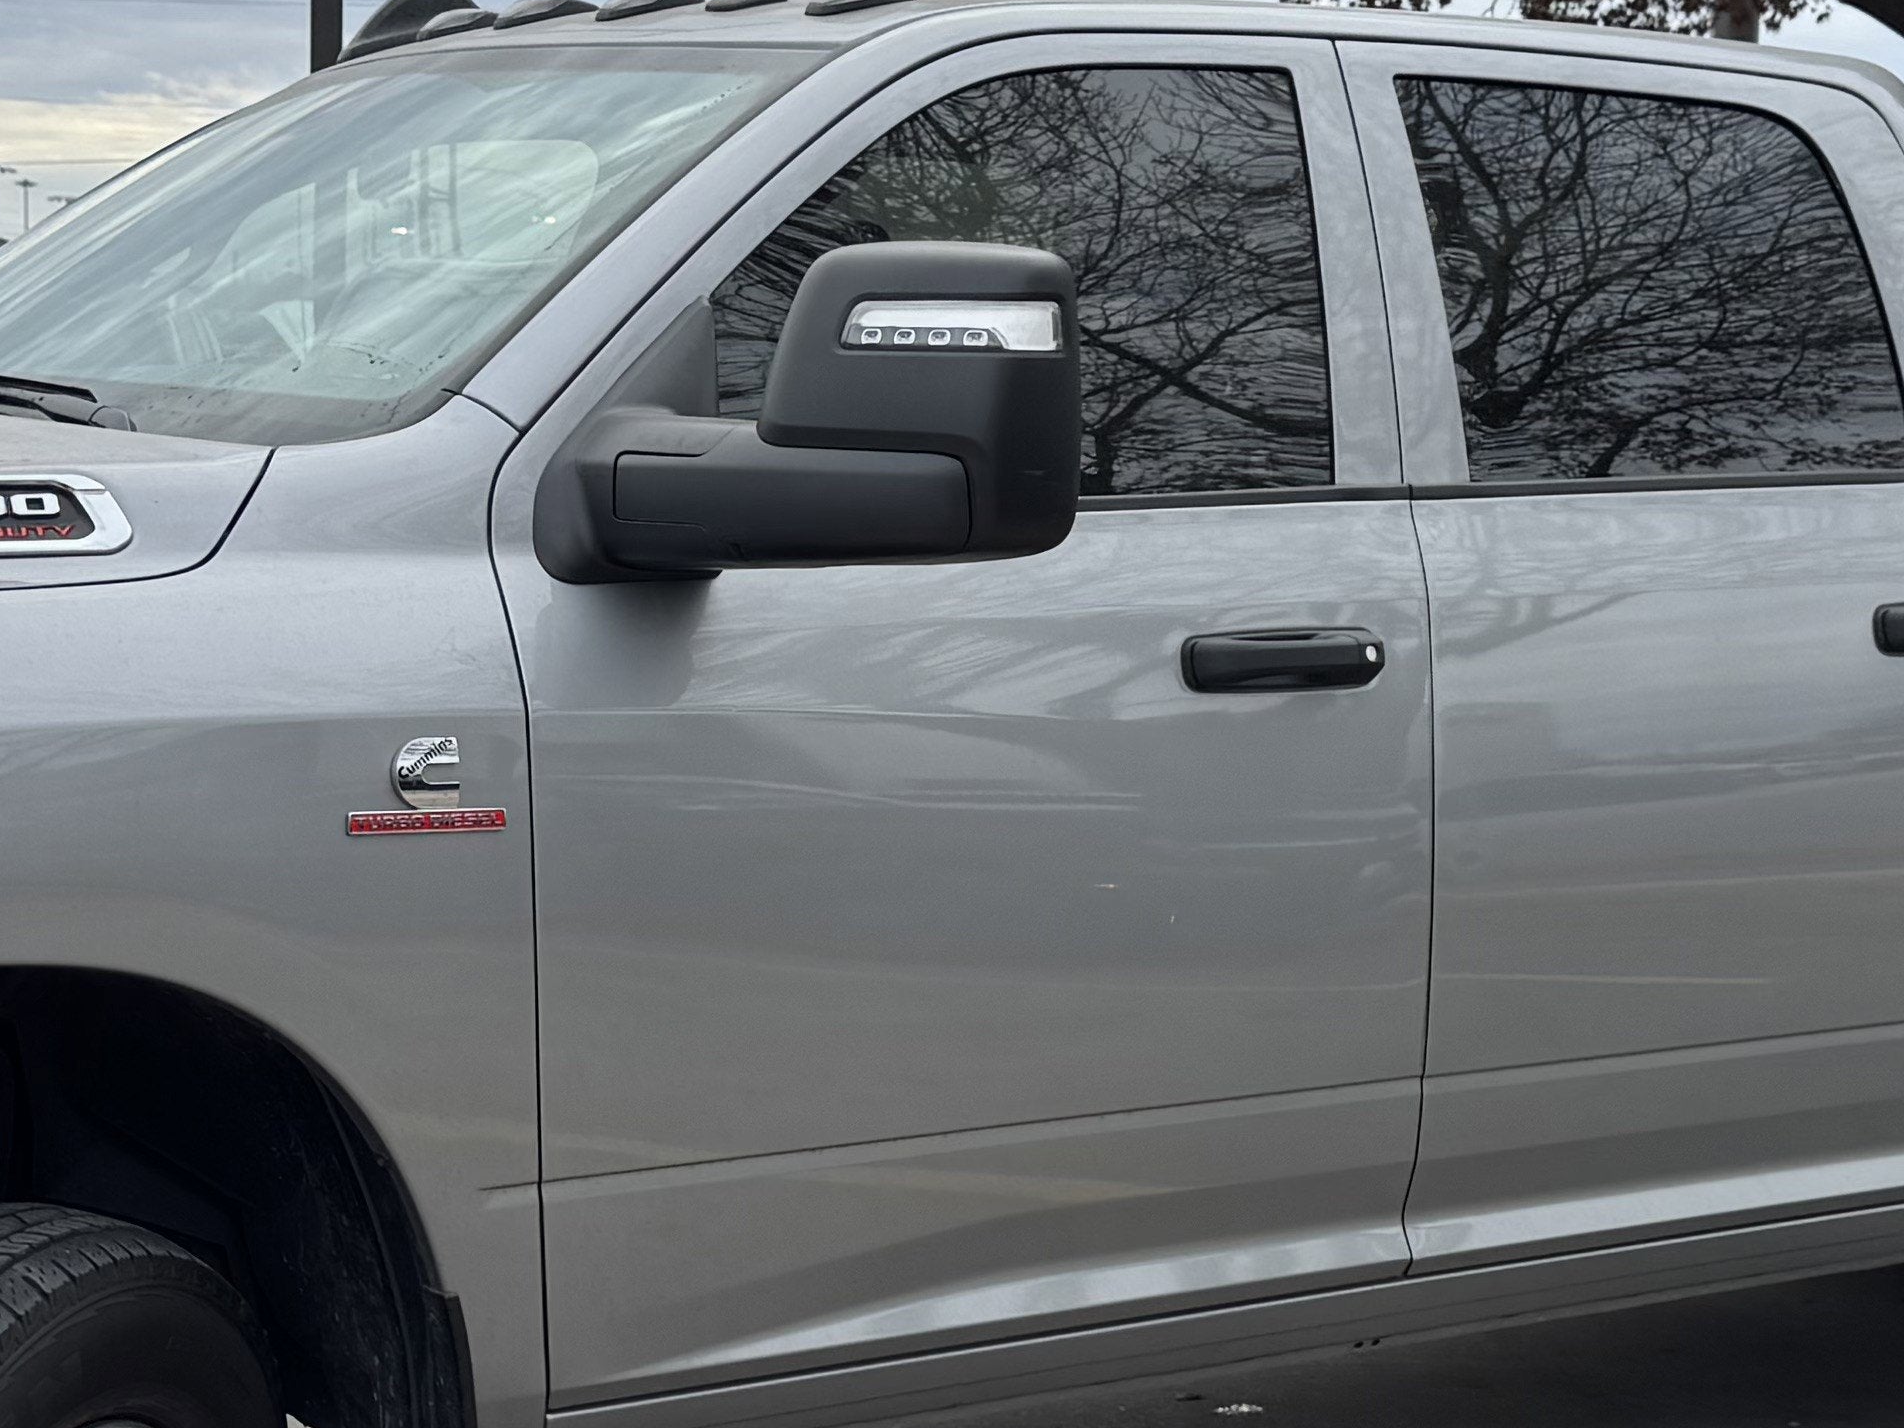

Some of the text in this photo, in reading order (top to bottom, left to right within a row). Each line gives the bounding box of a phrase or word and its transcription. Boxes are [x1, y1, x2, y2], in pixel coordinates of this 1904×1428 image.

[398, 739, 454, 779] Cummins
[352, 811, 504, 831] TURBO DIESEL
